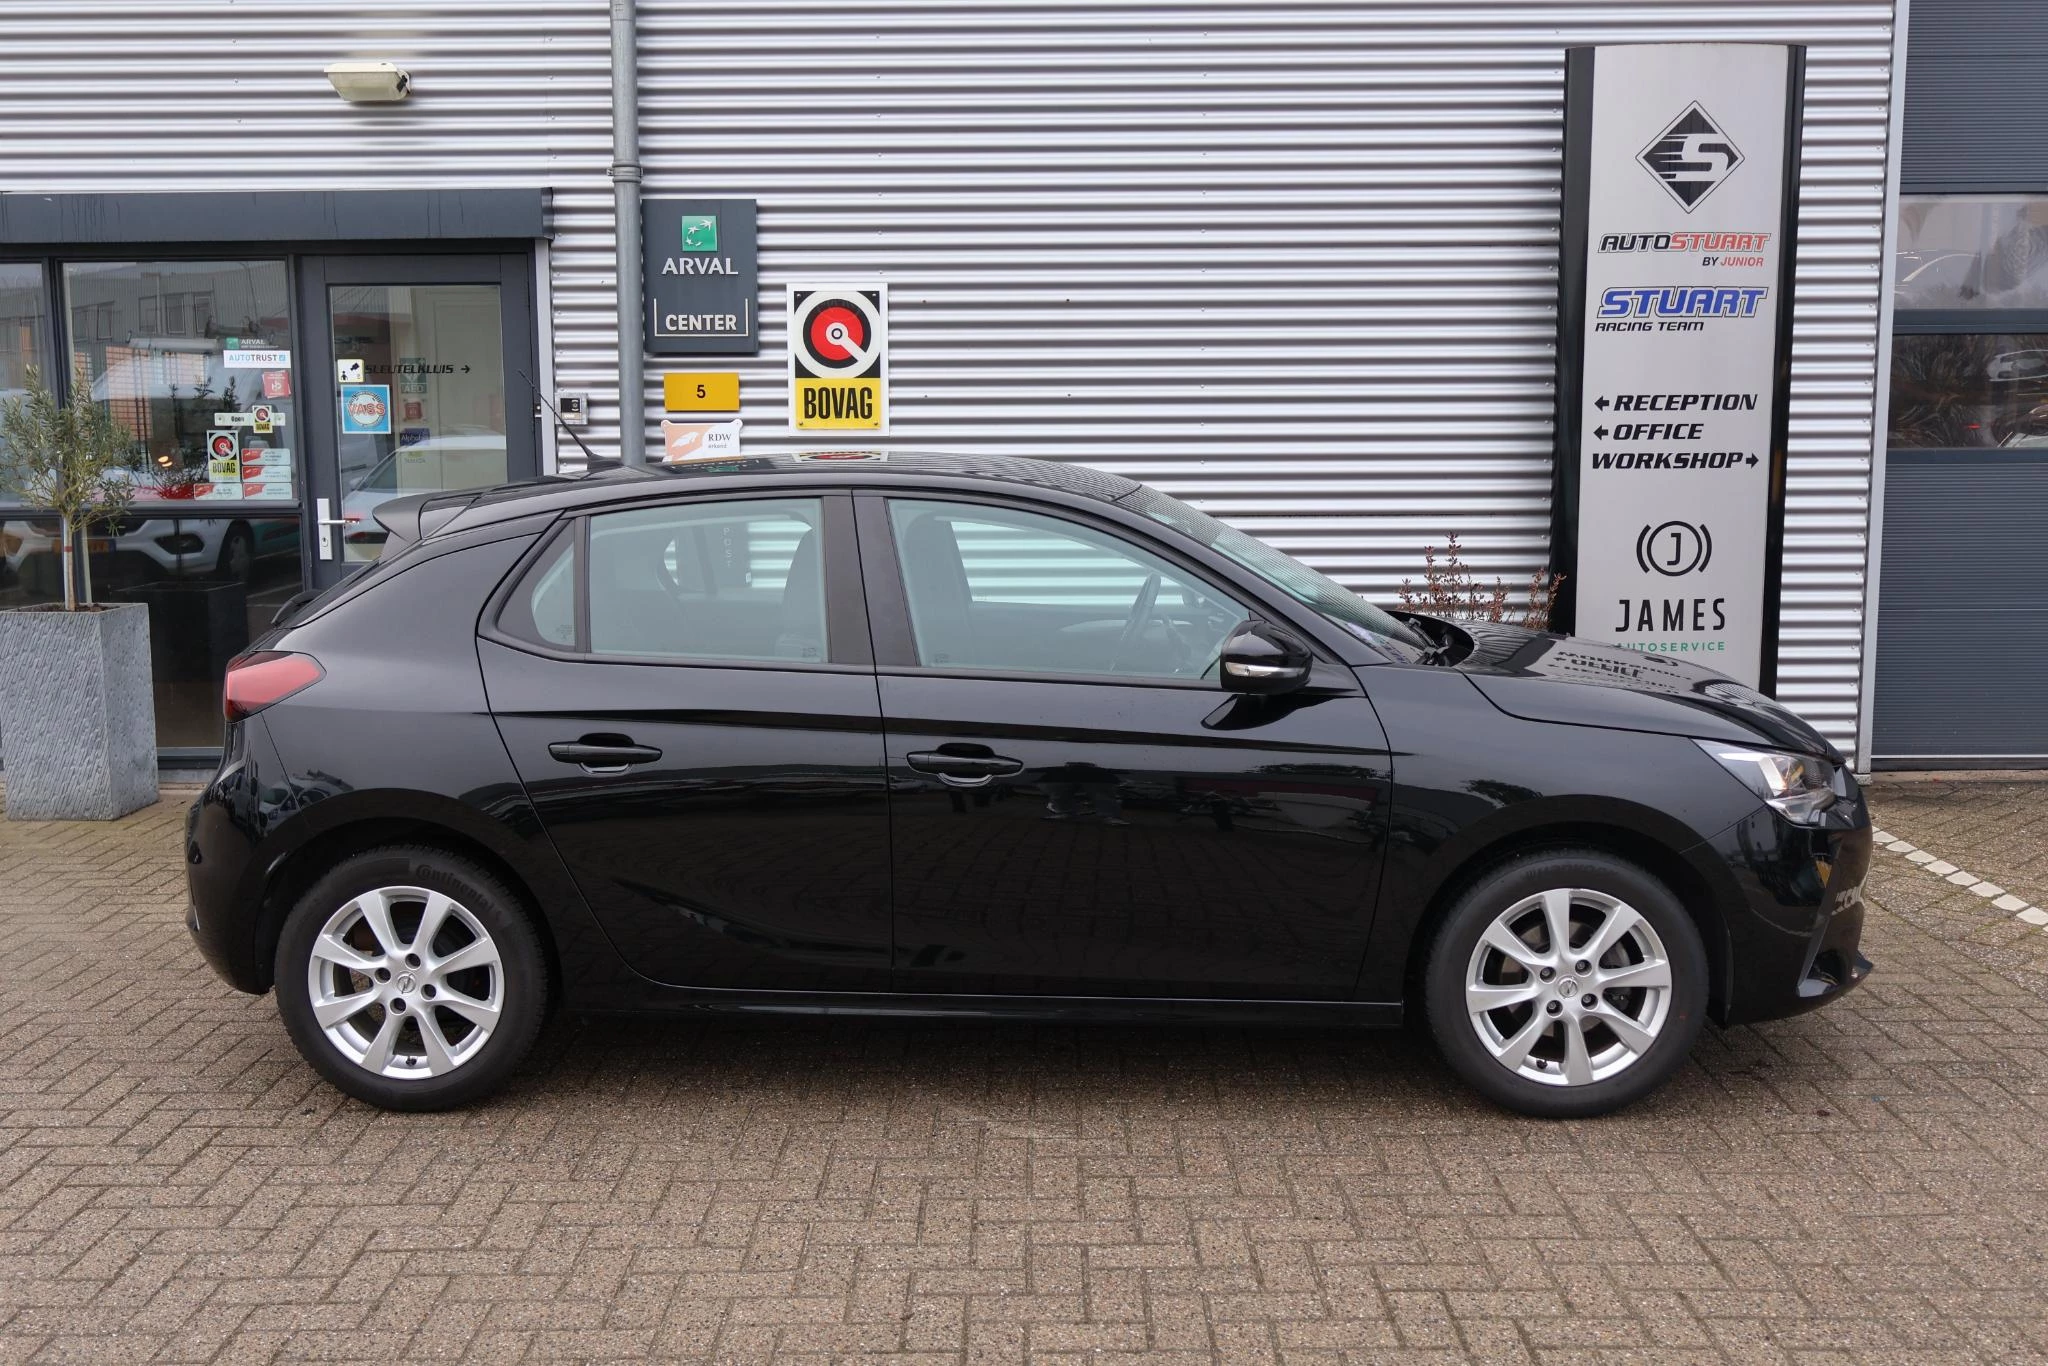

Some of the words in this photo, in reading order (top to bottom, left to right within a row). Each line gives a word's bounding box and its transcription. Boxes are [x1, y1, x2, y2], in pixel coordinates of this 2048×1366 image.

[1600, 233, 1770, 252] AUTOSTUART
[661, 257, 738, 275] ARVAL
[1702, 257, 1718, 267] BY
[1720, 257, 1764, 267] JUNIOR
[1598, 287, 1767, 318] STUART
[665, 314, 737, 331] CENTER
[1595, 322, 1653, 332] RACING
[1657, 321, 1704, 332] TEAM
[229, 354, 277, 362] AUTOTRUST
[365, 364, 454, 374] SLEUTELKLUIS
[404, 385, 424, 393] AED
[696, 384, 706, 399] 5
[348, 402, 386, 416] VASS
[804, 387, 873, 420] BOVAG
[1613, 394, 1758, 411] RECEPTION
[708, 433, 731, 442] RDW
[1612, 423, 1704, 440] OFFICE
[212, 462, 236, 474] BOVAG
[1592, 452, 1743, 469] WORKSHOP
[1615, 598, 1726, 633] JAMES
